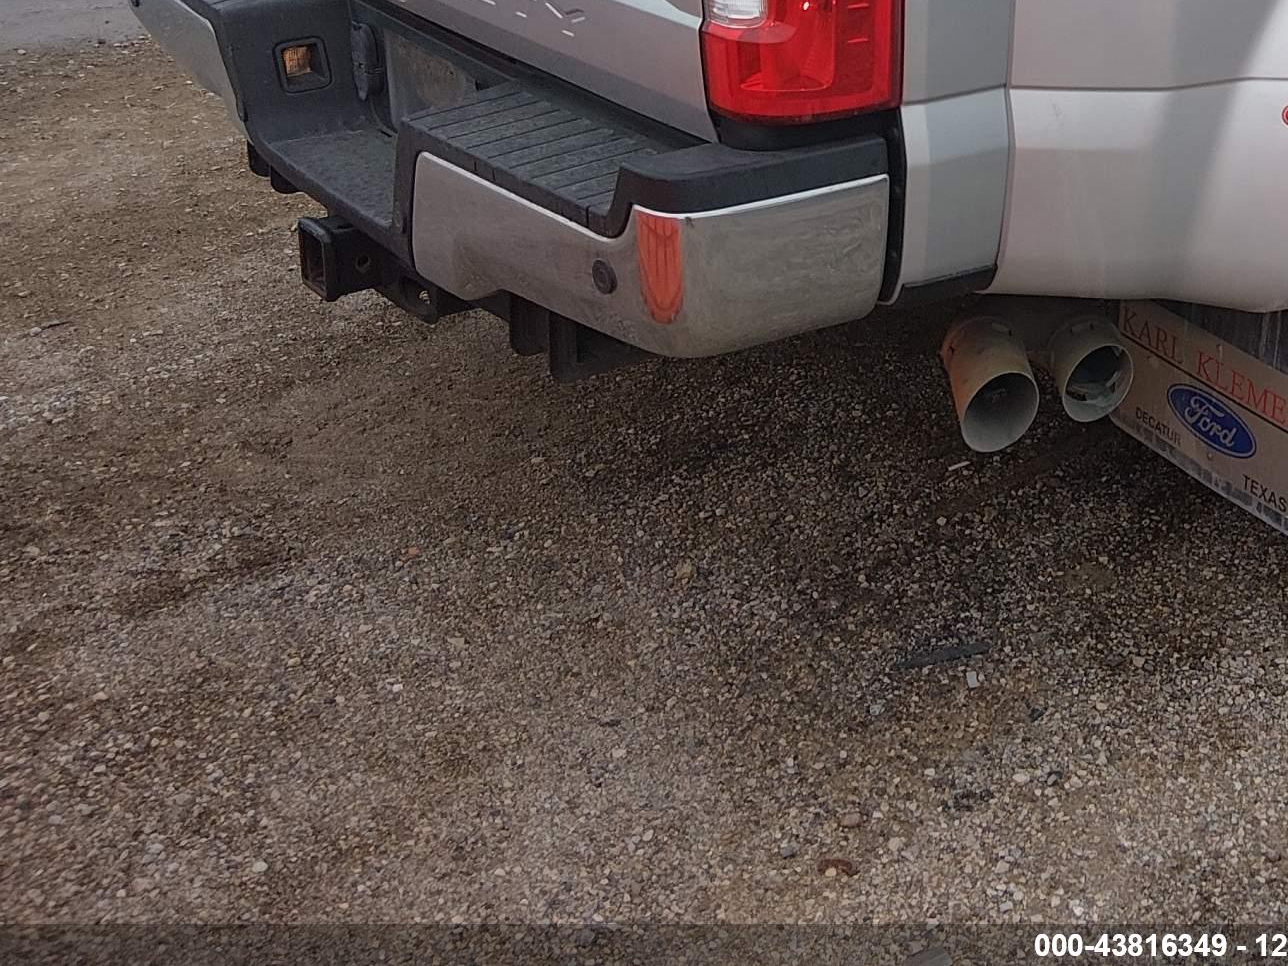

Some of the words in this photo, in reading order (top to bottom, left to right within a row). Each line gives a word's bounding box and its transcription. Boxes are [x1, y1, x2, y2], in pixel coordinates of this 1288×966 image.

[1121, 305, 1185, 365] KARL
[1135, 406, 1182, 449] DECATUR
[1183, 394, 1237, 449] Ford
